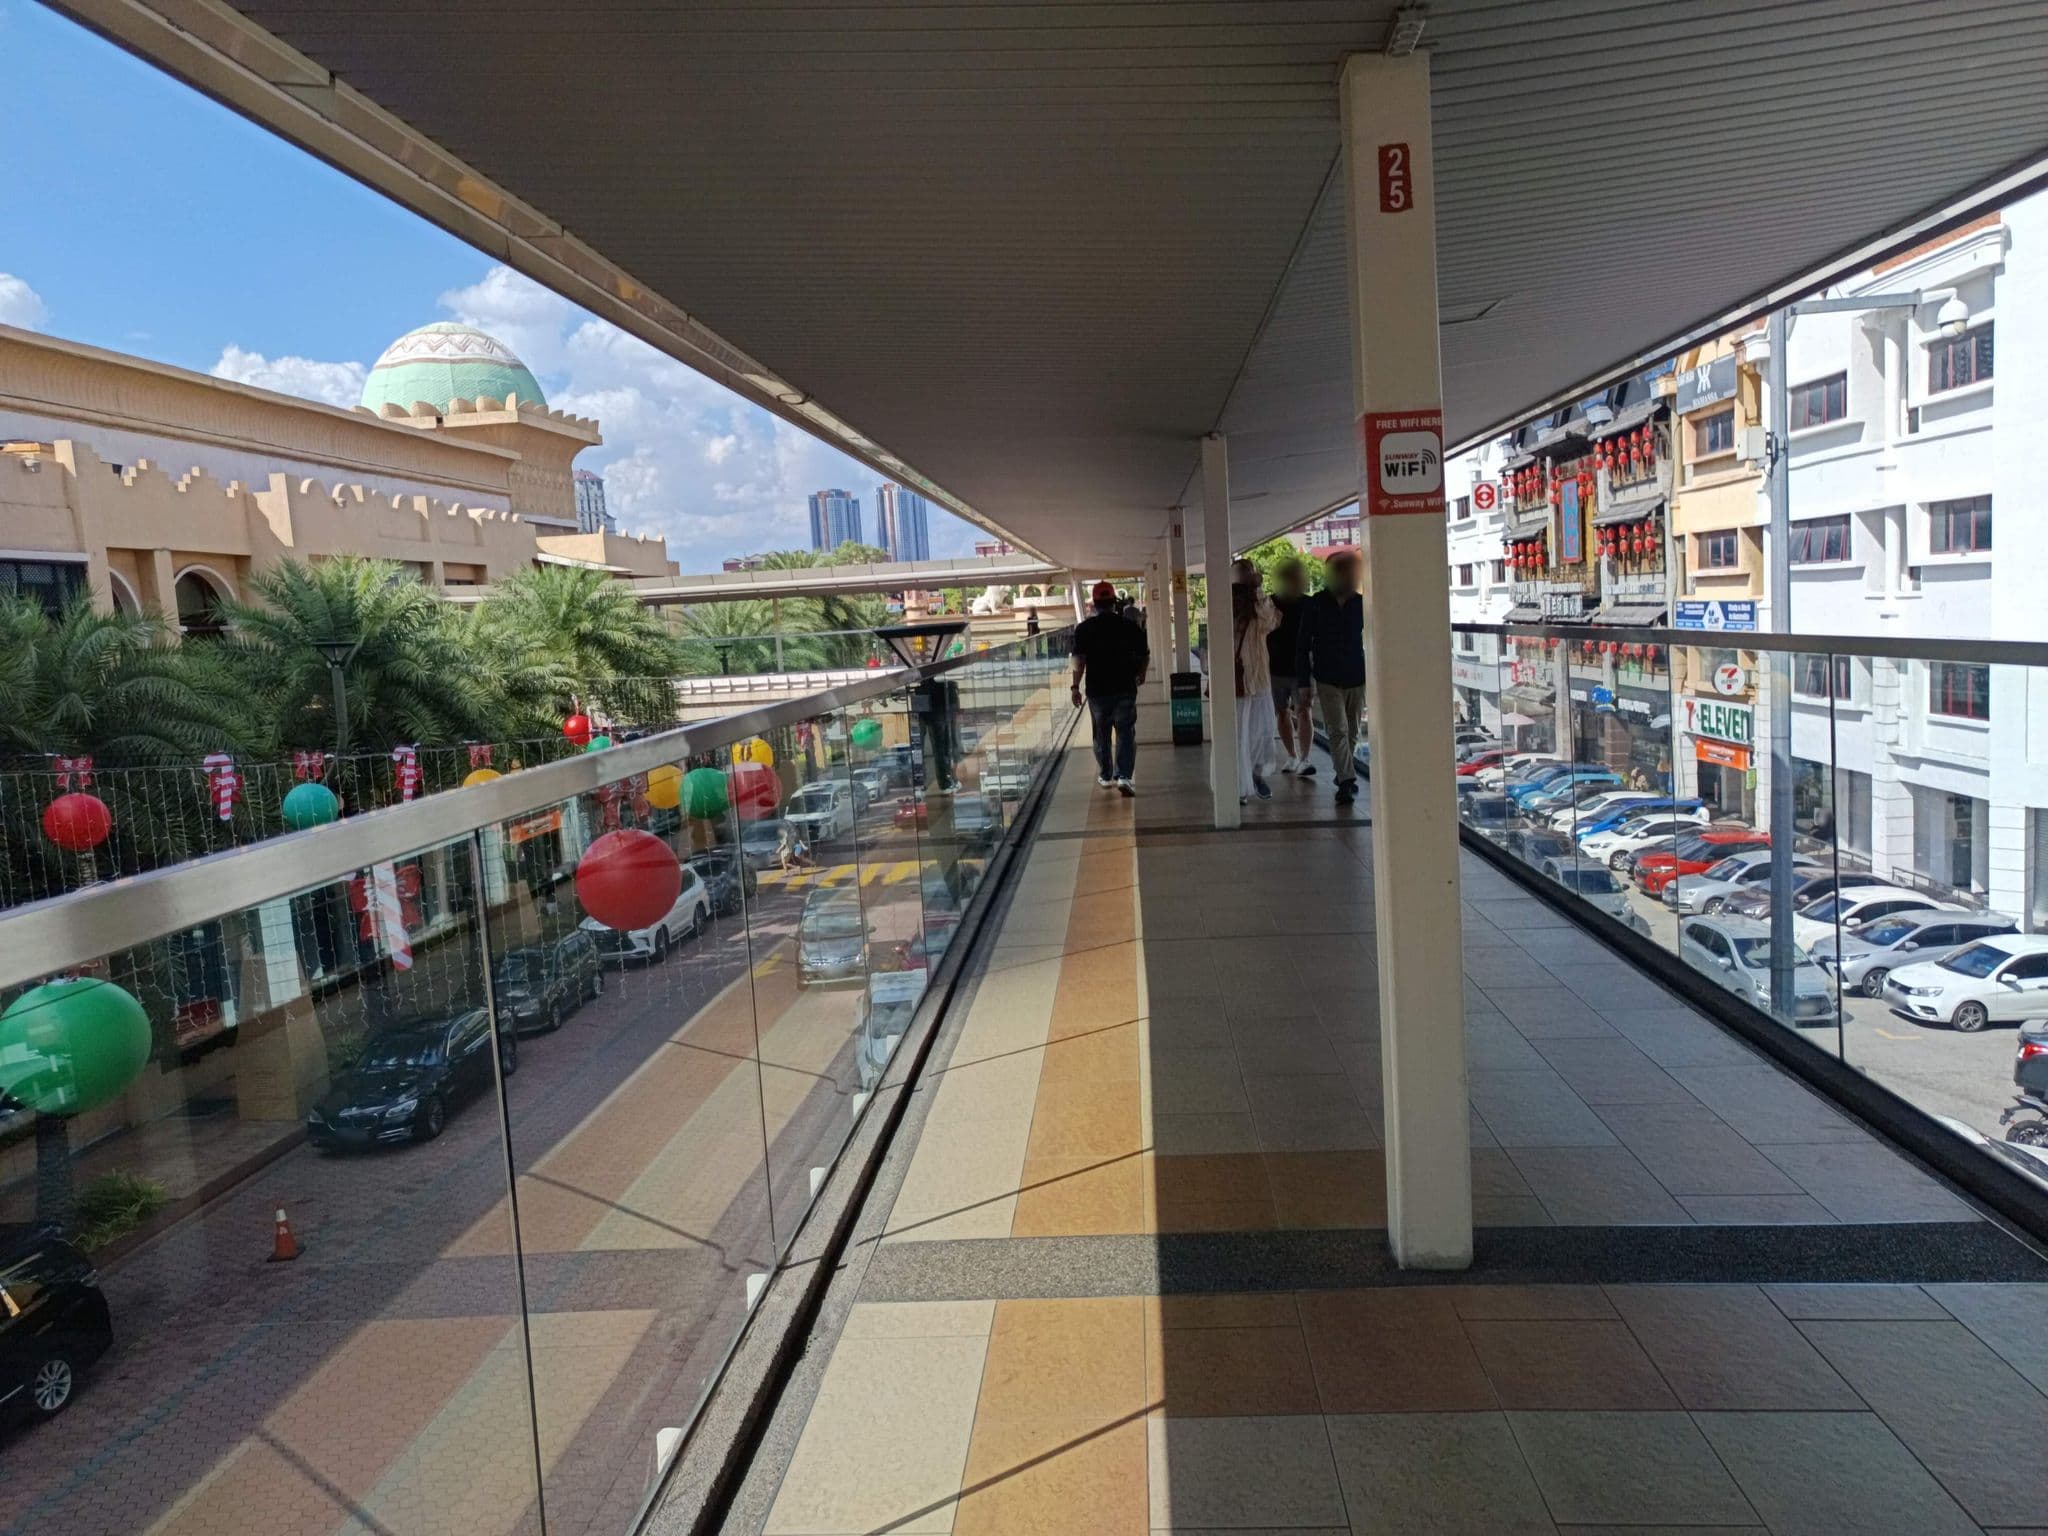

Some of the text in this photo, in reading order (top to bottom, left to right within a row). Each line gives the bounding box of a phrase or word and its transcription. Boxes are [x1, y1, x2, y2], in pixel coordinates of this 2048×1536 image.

[1388, 148, 1405, 209] 25
[1376, 417, 1442, 430] FREE WIFI HERE
[1384, 453, 1418, 461] SUNWAY
